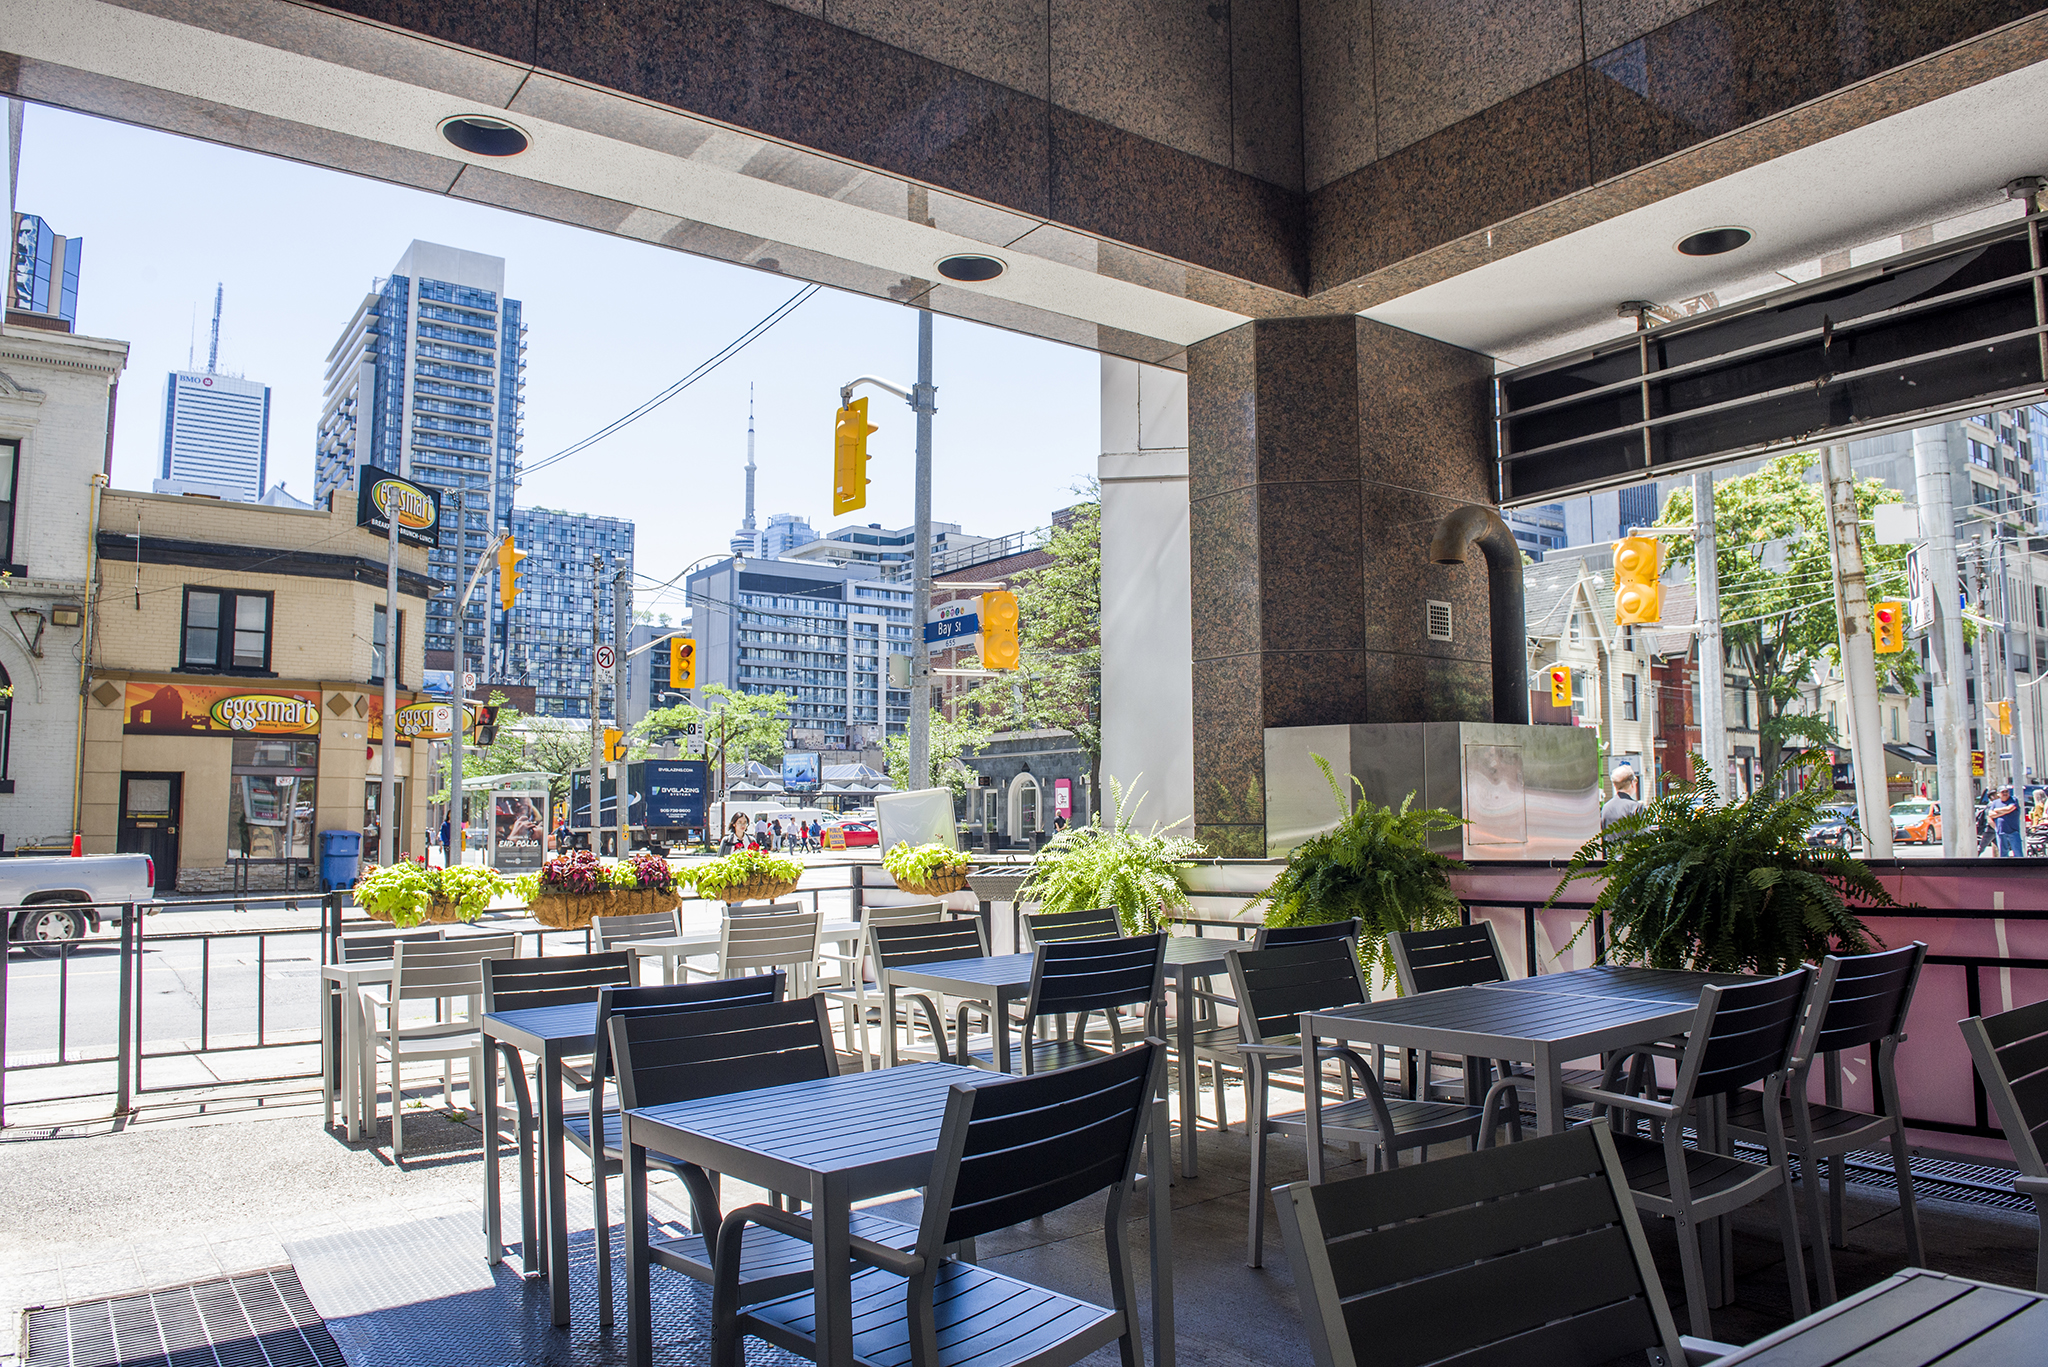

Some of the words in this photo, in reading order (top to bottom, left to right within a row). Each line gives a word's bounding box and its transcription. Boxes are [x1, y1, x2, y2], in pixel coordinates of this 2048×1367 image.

[180, 375, 201, 384] BMO
[938, 622, 952, 637] Bay
[955, 621, 961, 632] St
[945, 638, 956, 647] 655
[222, 698, 315, 731] eggsmart
[498, 840, 514, 848] END
[515, 839, 539, 848] POLIO
